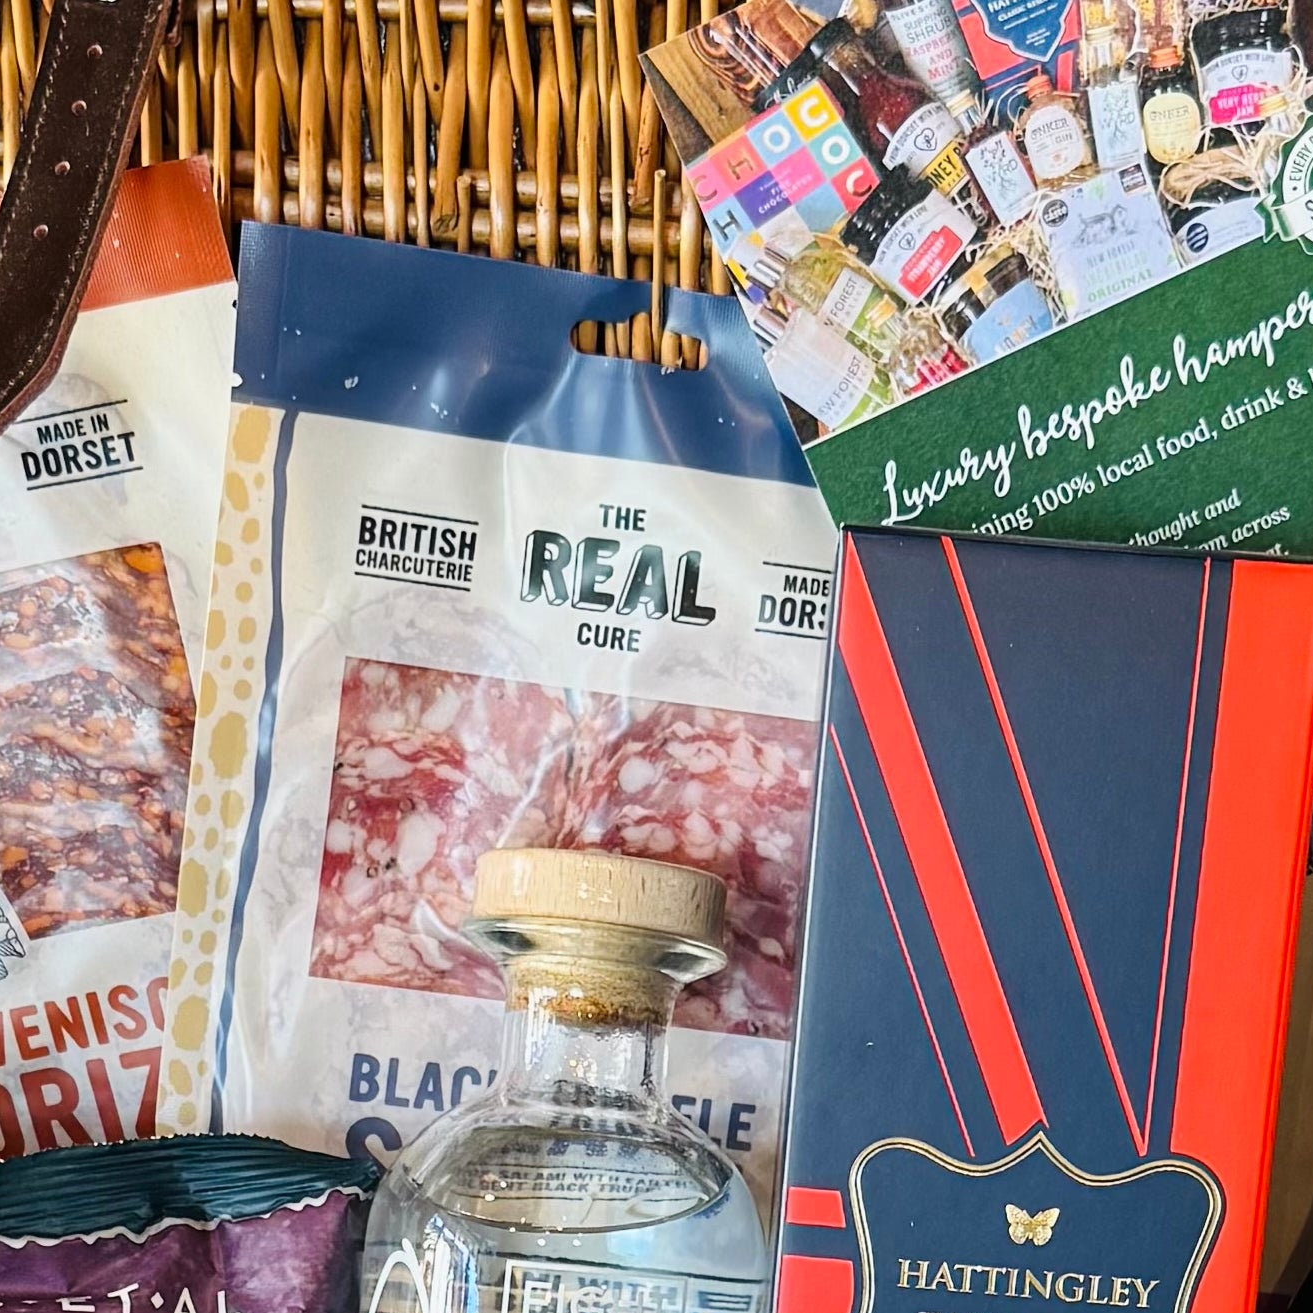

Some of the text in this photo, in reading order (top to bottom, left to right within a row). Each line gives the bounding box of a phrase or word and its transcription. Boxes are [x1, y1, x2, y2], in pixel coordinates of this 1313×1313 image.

[37, 415, 110, 445] MADE IN
[881, 459, 1016, 526] Luxury
[1018, 354, 1171, 462] bespoke
[1031, 471, 1097, 518] 100%
[1096, 441, 1153, 488] local
[1155, 418, 1219, 459] food,
[1220, 388, 1284, 433] drink
[1286, 377, 1308, 401] &
[21, 431, 136, 482] DORSET
[358, 516, 478, 562] BRITISH
[600, 504, 647, 532] THE
[355, 549, 474, 583] CHARCUTERIE
[520, 530, 716, 627] REAL
[577, 622, 640, 653] CURE
[897, 1258, 1160, 1308] HATTINGLEY
